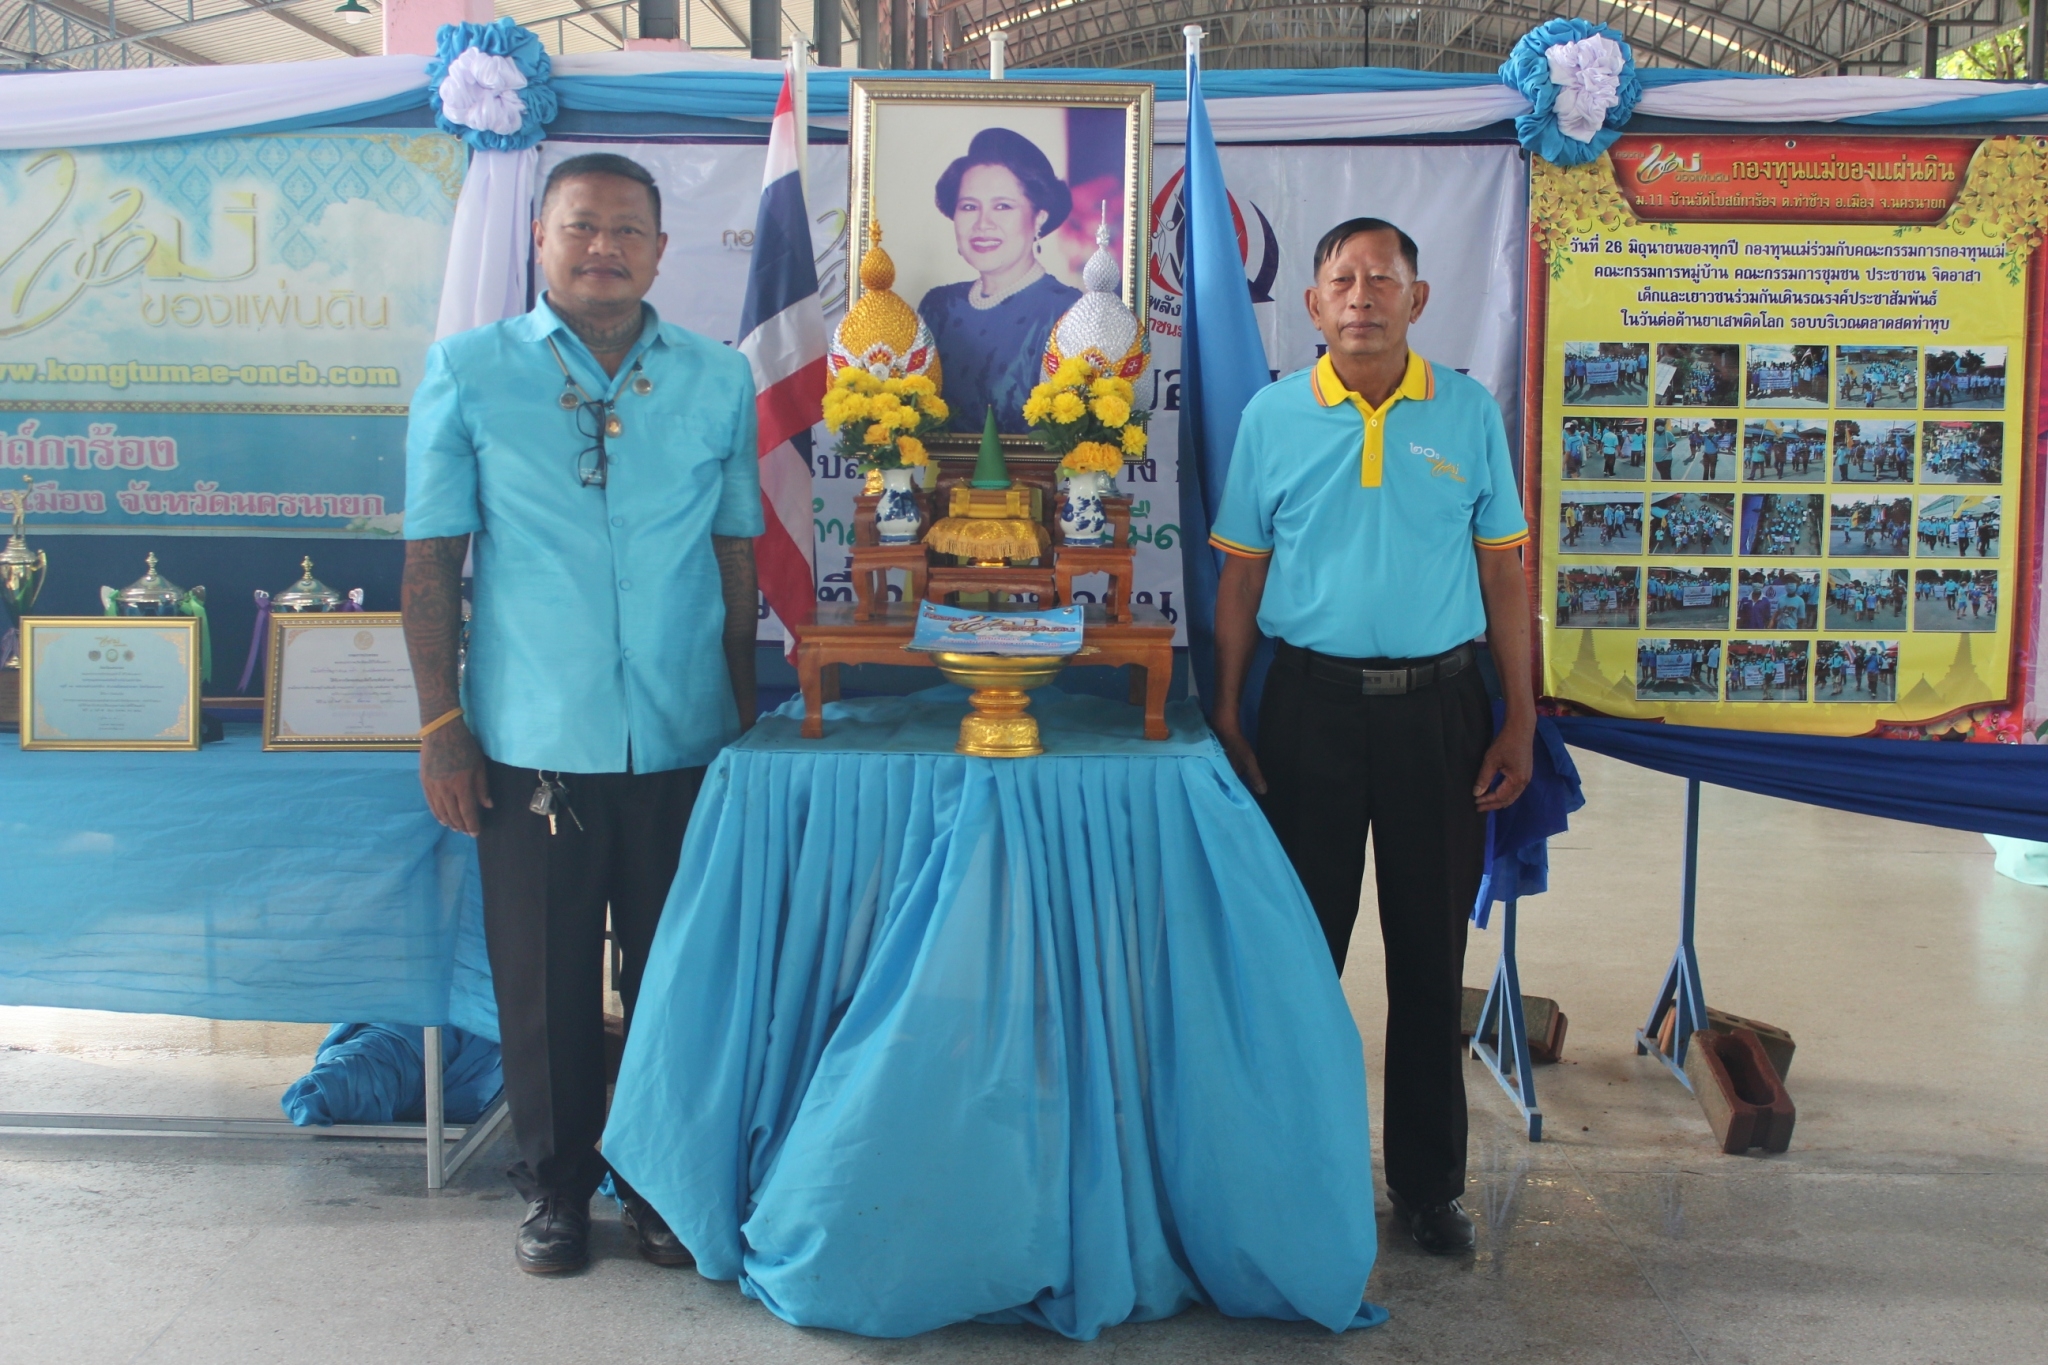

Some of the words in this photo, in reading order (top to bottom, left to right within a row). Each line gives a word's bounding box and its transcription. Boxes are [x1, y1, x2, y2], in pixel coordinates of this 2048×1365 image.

[1731, 153, 1956, 188] กองทุนแม่ของแผ่นดิน
[1635, 193, 1664, 206] ม.11
[1669, 190, 1777, 207] บ้านวัดโบสถ์การ้อง
[1835, 193, 1875, 208] อ.เมือง
[1880, 196, 1946, 209] จ.นครนายก
[1570, 234, 1600, 253] วันที่
[1605, 240, 1623, 254] 26
[1628, 239, 1739, 259] มิถุนายนของทุกปี
[1744, 241, 2005, 262] กองทุนแม่ร่วมกับคณะกรรมการกองทุนแม่
[1594, 264, 1729, 283] คณะกรรมการหมู่บ้าน
[1734, 266, 1859, 284] คณะกรรมการชุมชน
[1866, 267, 1926, 282] ประชาชน
[1932, 267, 1981, 282] จิตอาสา
[140, 280, 390, 328] ของแผ่นดิน
[1638, 286, 1937, 306] เด็กและเยาวชนร่วมกันเดินรณรงค์ประชาสัมพันธ์
[1621, 309, 1784, 328] ในวันต่อต้านยาเสพติดโลก
[1790, 313, 1950, 334] รอบบริเวณตลาดสดท่าหุบ
[117, 480, 385, 516] จังหวัดนครนายก
